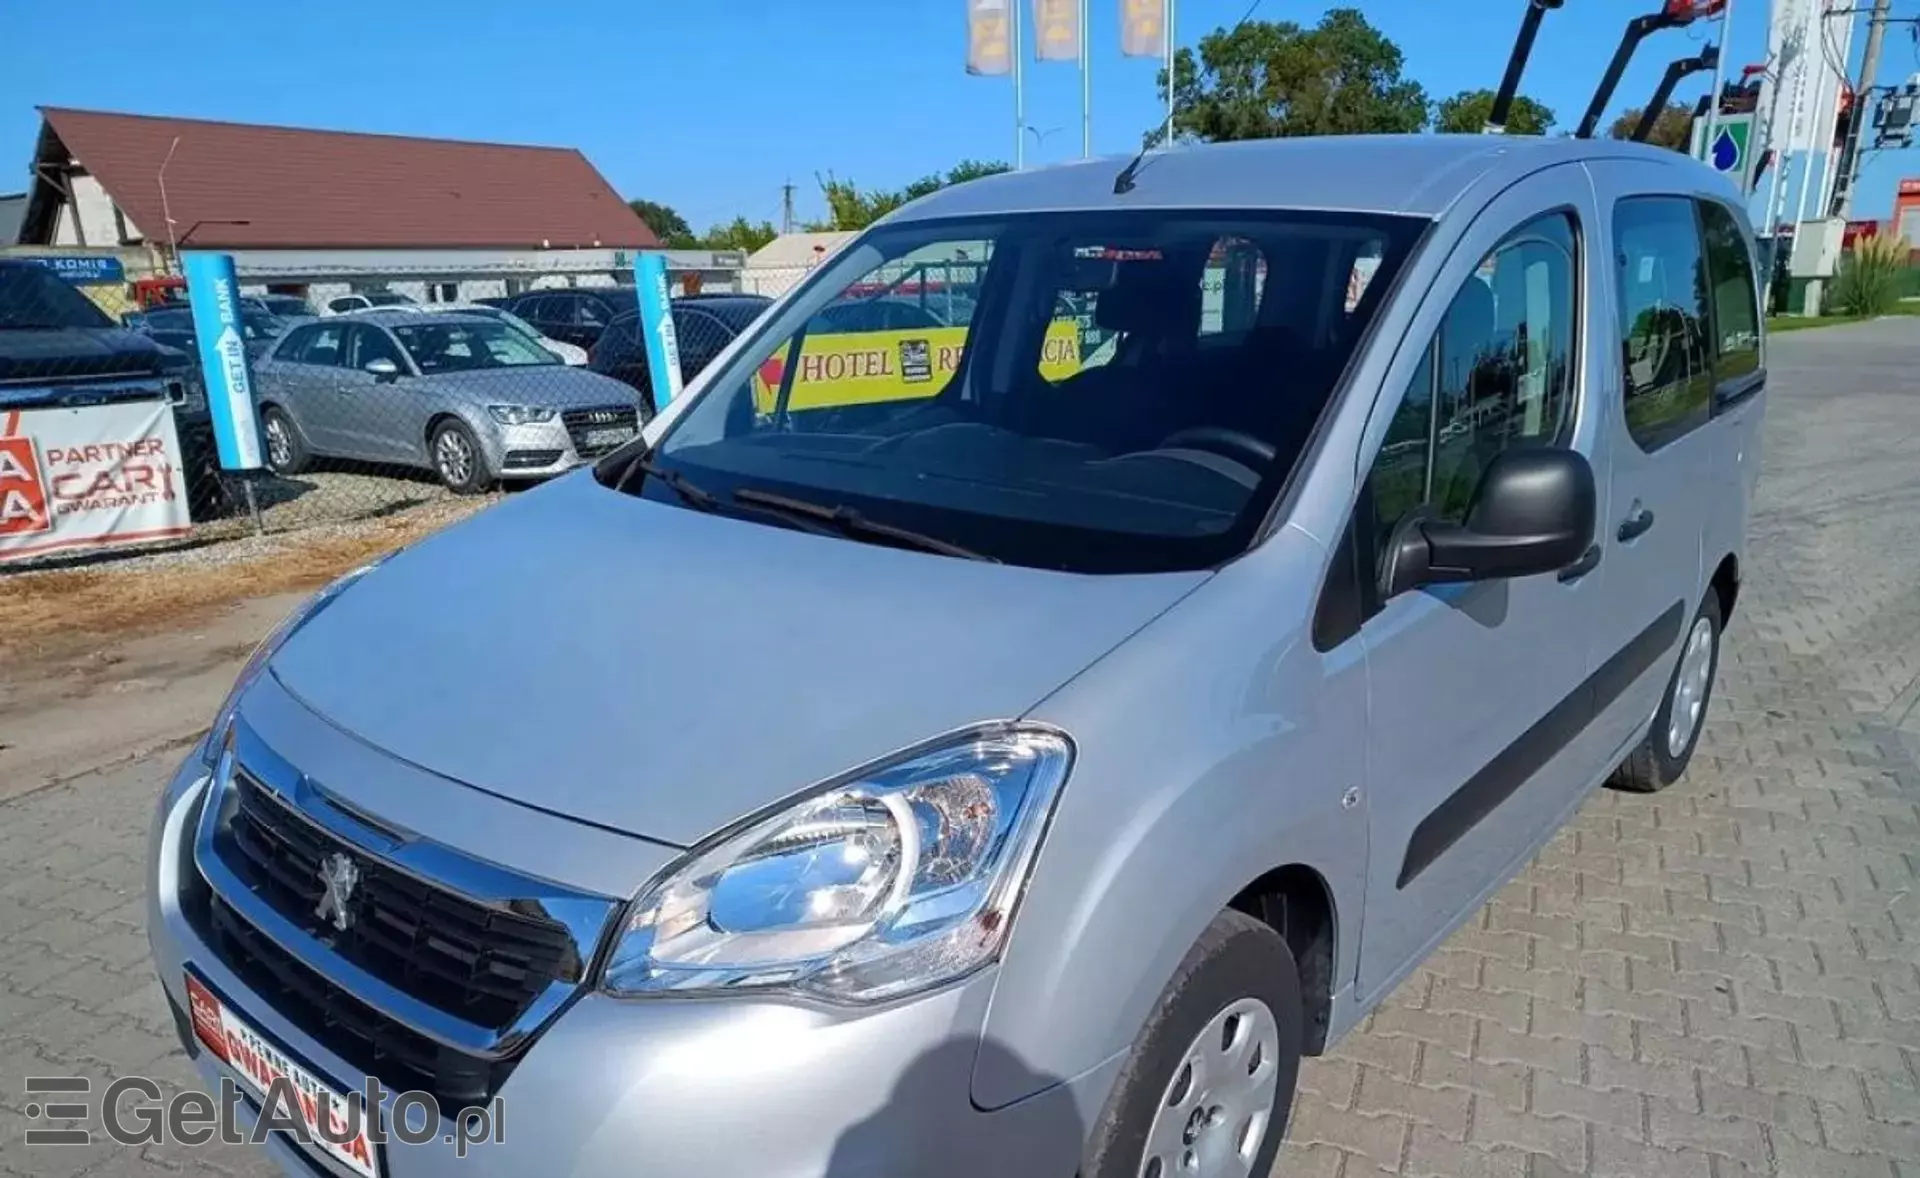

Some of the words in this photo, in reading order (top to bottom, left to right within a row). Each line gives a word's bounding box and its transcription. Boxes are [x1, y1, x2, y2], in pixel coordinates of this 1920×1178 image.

[55, 259, 107, 270] KOMIS
[213, 278, 234, 325] BANK
[224, 339, 240, 358] IN
[228, 361, 245, 394] GET
[800, 350, 893, 382] HOTEL
[46, 438, 165, 467] PARTNER
[51, 464, 156, 501] CAR
